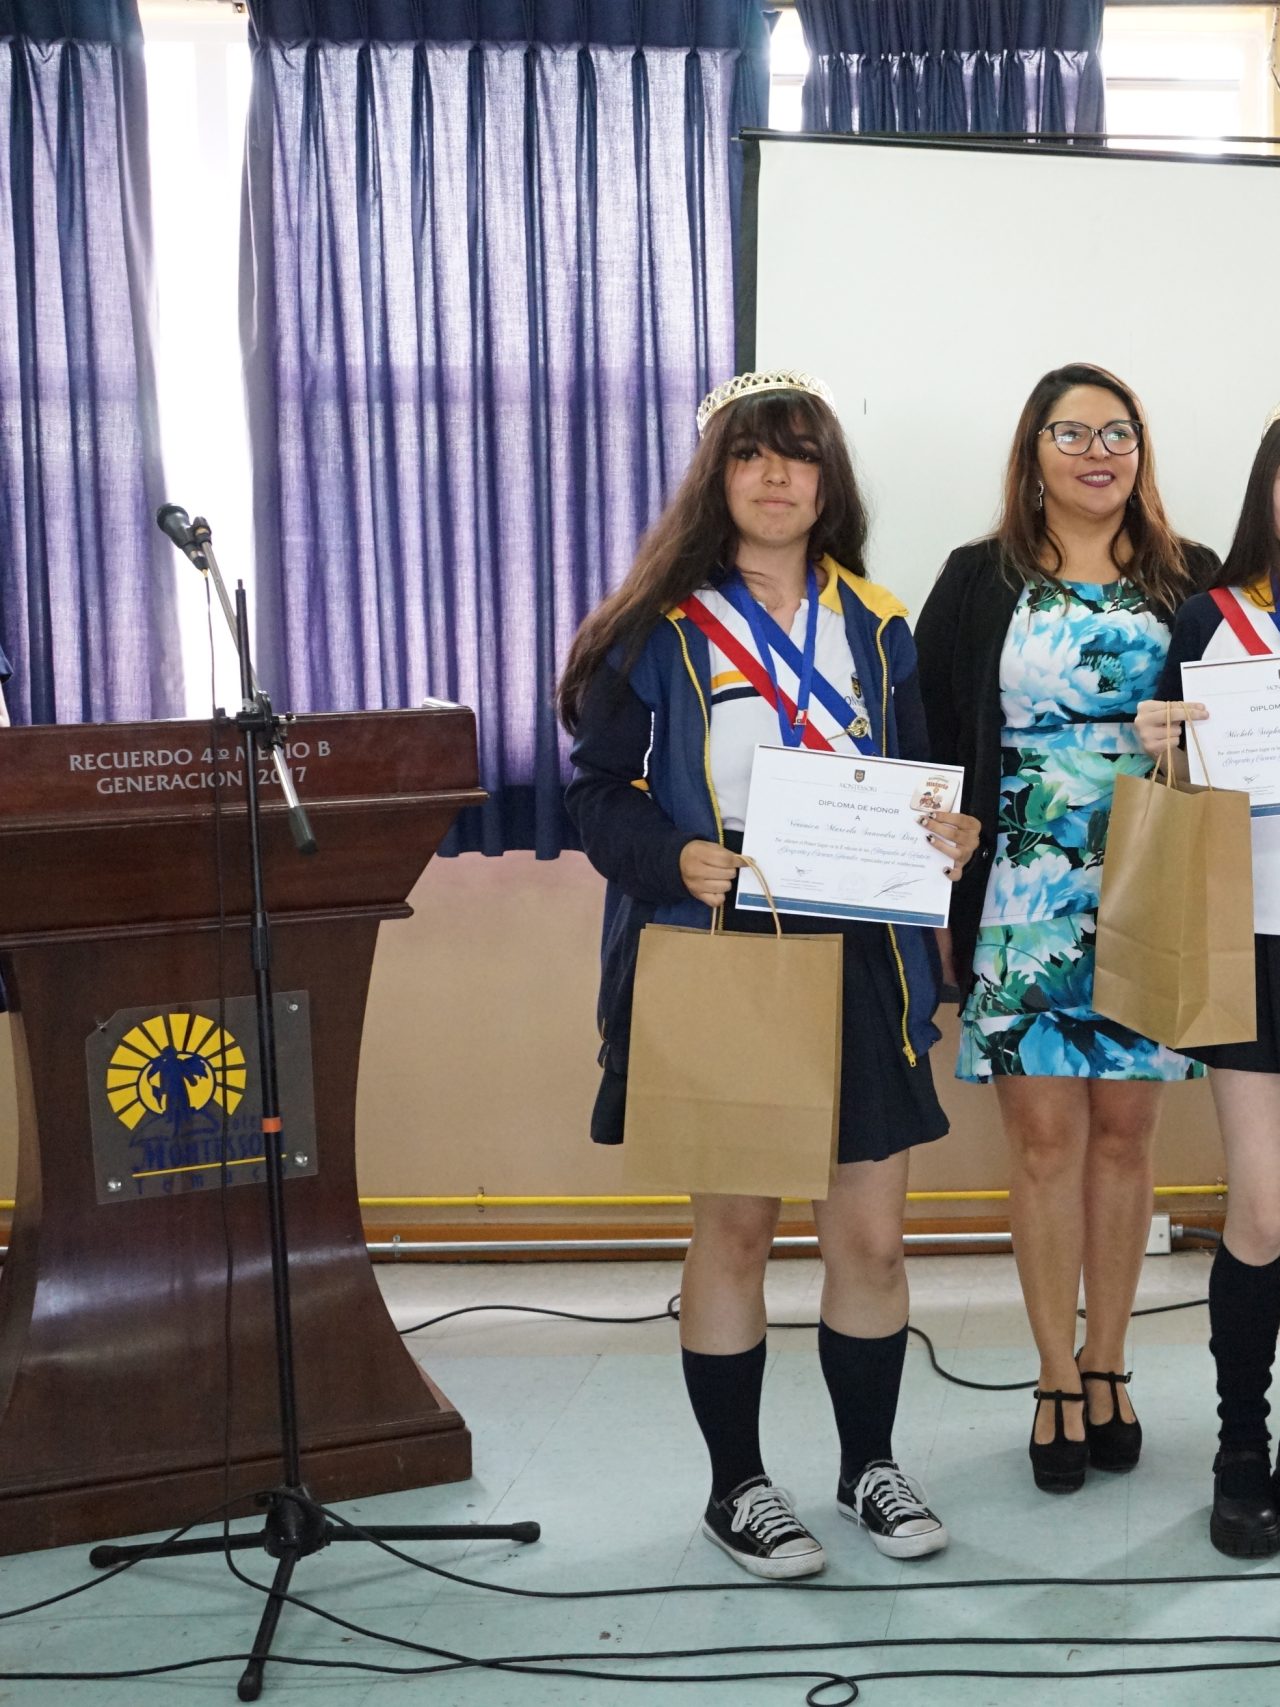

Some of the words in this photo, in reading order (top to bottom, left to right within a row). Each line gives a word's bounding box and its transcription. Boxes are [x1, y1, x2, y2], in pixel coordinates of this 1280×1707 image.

[69, 748, 193, 771] RECUERDO
[235, 742, 311, 762] EIO
[318, 740, 331, 757] B
[96, 769, 243, 795] GENERACION
[818, 799, 855, 810] DIPLOMA
[857, 804, 868, 812] DE
[870, 806, 900, 815] HONOR
